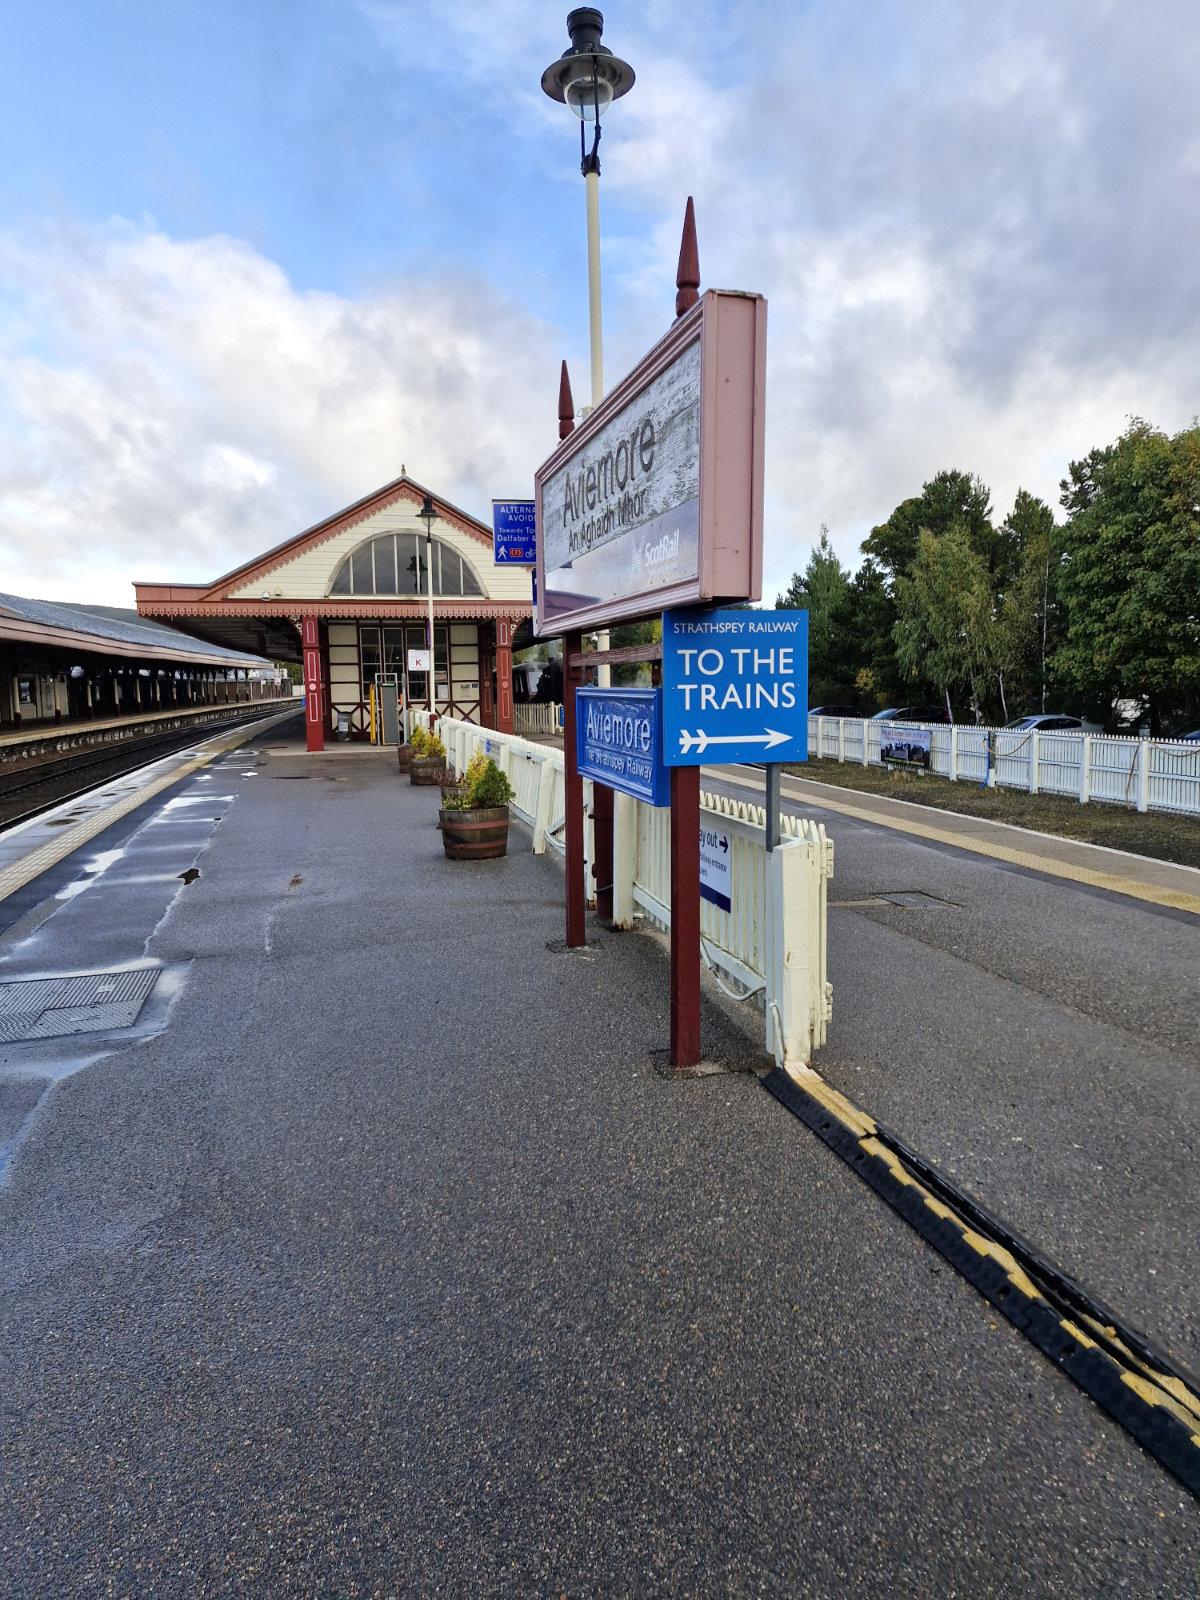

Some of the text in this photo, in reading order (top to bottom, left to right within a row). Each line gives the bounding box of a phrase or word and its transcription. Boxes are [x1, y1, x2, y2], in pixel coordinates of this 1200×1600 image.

[563, 418, 656, 527] Aviemore
[497, 534, 529, 542] Dalfaber
[568, 528, 579, 554] An
[645, 528, 680, 567] ScotRail
[673, 622, 798, 634] STRATHSPEY RAILWAY
[415, 659, 422, 667] K
[677, 648, 794, 676] TO THE
[677, 682, 796, 711] TRAINS
[586, 702, 651, 752] Aviemore
[627, 756, 652, 783] Railway
[707, 832, 718, 849] out
